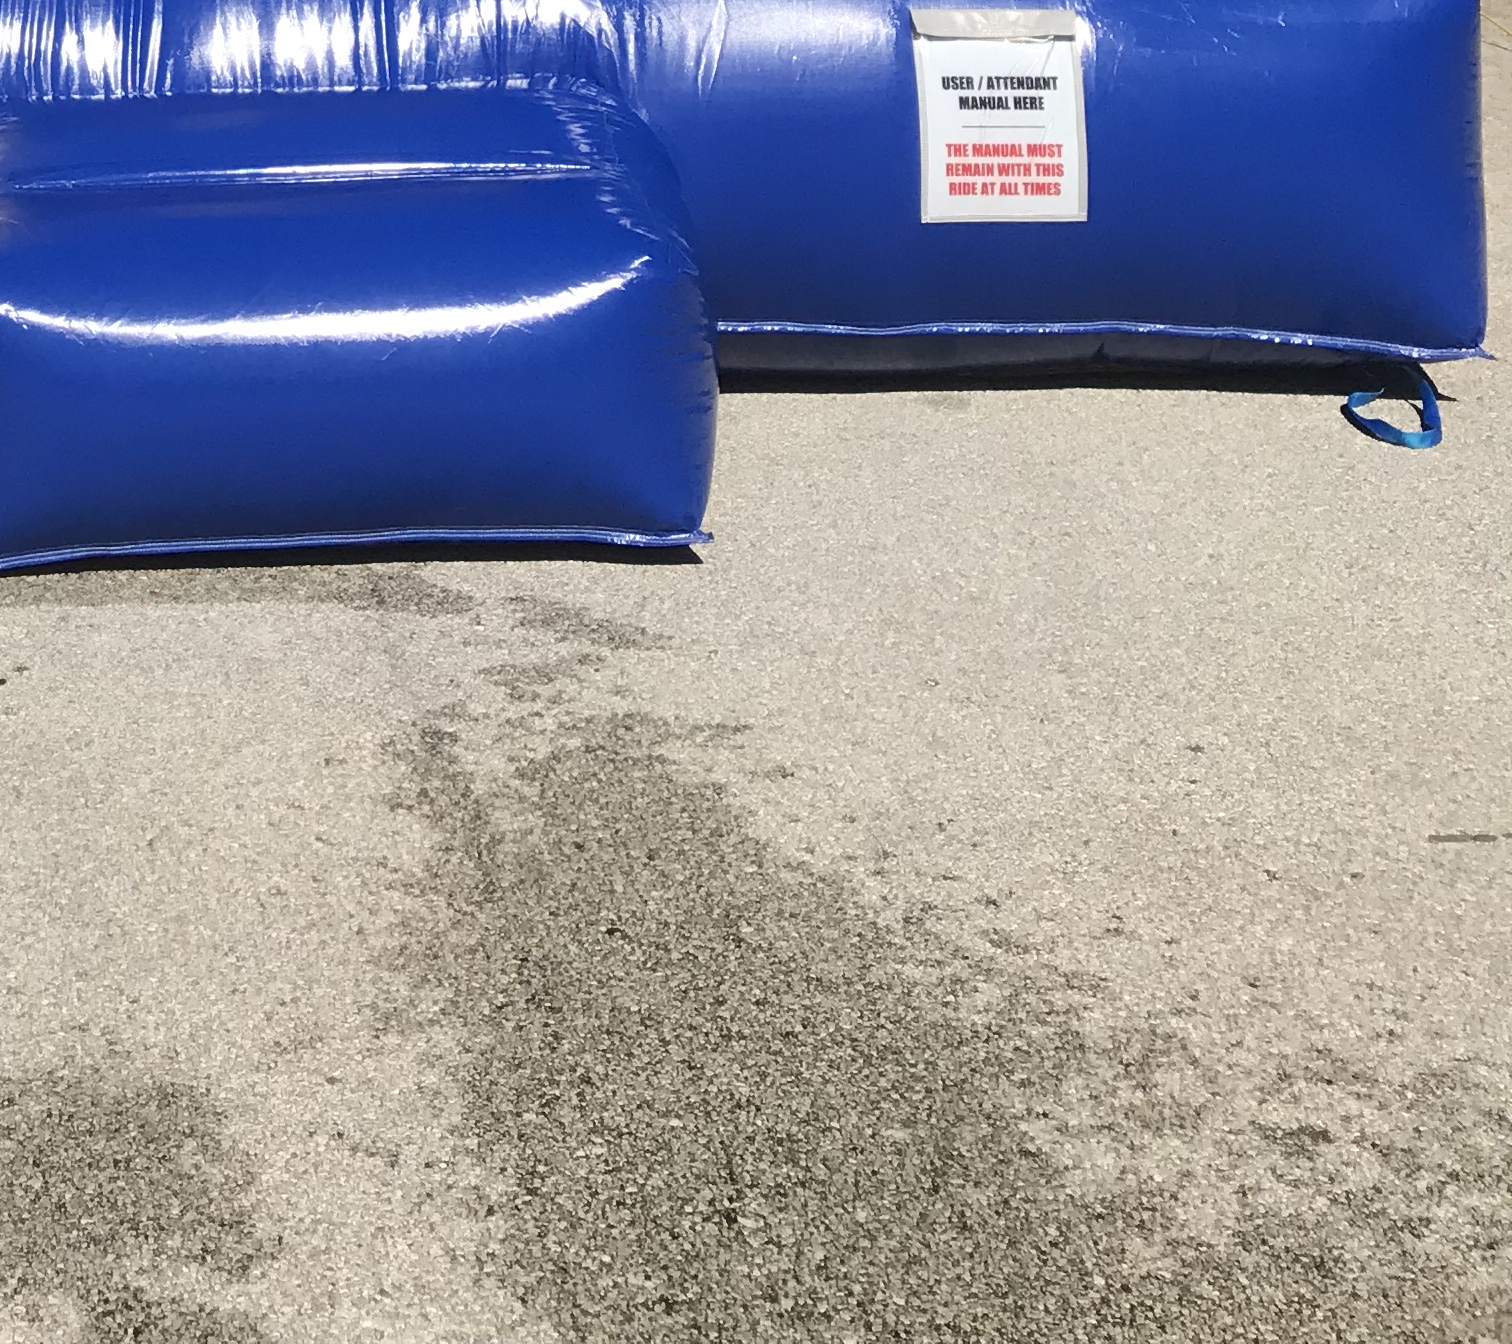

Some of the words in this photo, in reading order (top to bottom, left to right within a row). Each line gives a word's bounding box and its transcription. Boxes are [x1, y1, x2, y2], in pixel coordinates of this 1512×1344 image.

[942, 76, 974, 90] USER
[978, 76, 983, 91] /
[987, 76, 1058, 91] ATTENDANT
[959, 96, 1010, 110] MANUAL
[1013, 97, 1045, 110] HERE
[946, 144, 969, 157] THE
[972, 144, 1024, 157] MANUAL
[1027, 144, 1063, 157] MUST
[946, 164, 994, 176] REMAIN
[998, 164, 1031, 176] WITH
[1034, 164, 1064, 176] THIS
[949, 183, 977, 195] RIDE
[981, 183, 996, 195] AT
[999, 183, 1019, 195] ALL
[1023, 183, 1061, 195] TIMES
